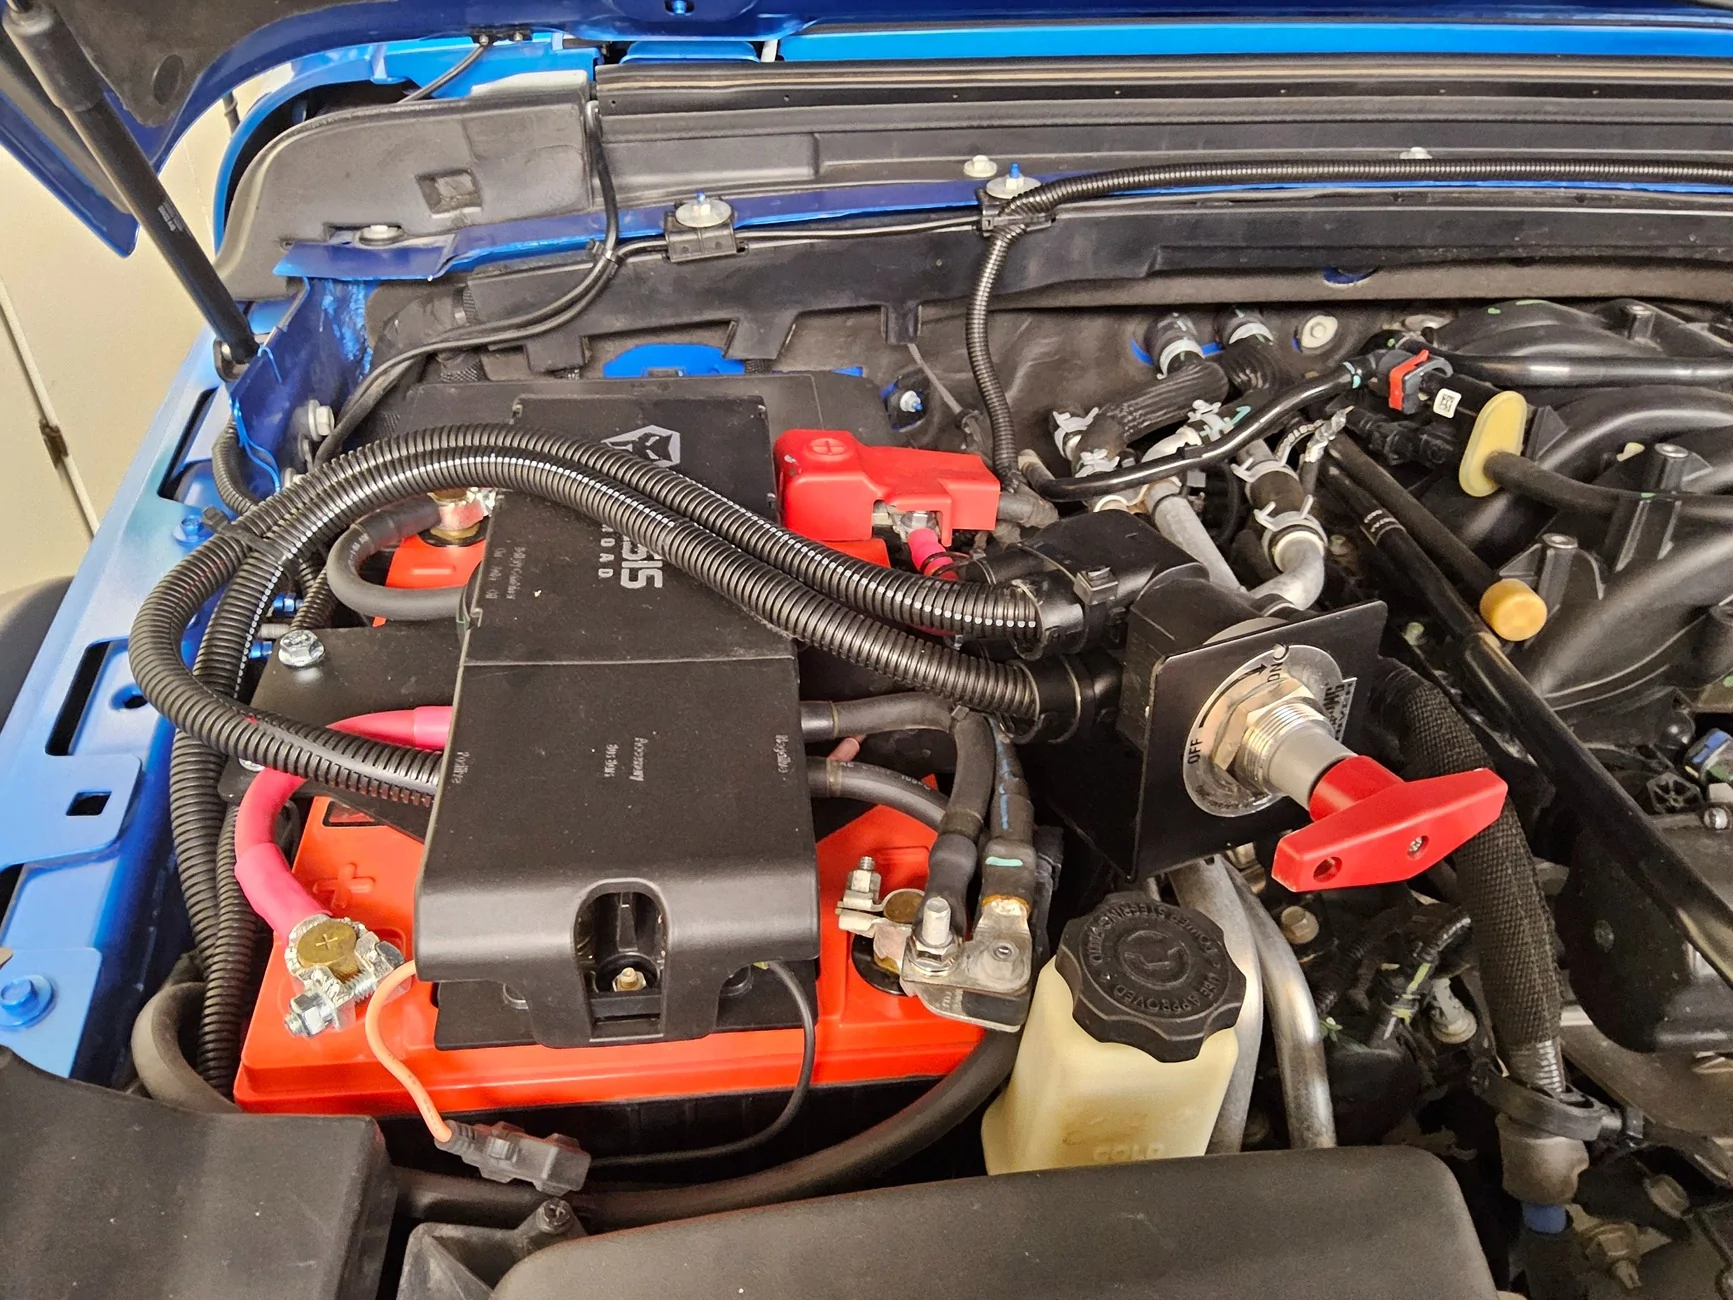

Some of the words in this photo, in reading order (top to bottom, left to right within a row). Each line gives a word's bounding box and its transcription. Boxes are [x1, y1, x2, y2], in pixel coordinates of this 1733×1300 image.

[1267, 662, 1283, 683] ON
[1187, 738, 1203, 765] OFF
[1100, 902, 1168, 930] STEERING
[1113, 984, 1201, 1015] APPROVED
